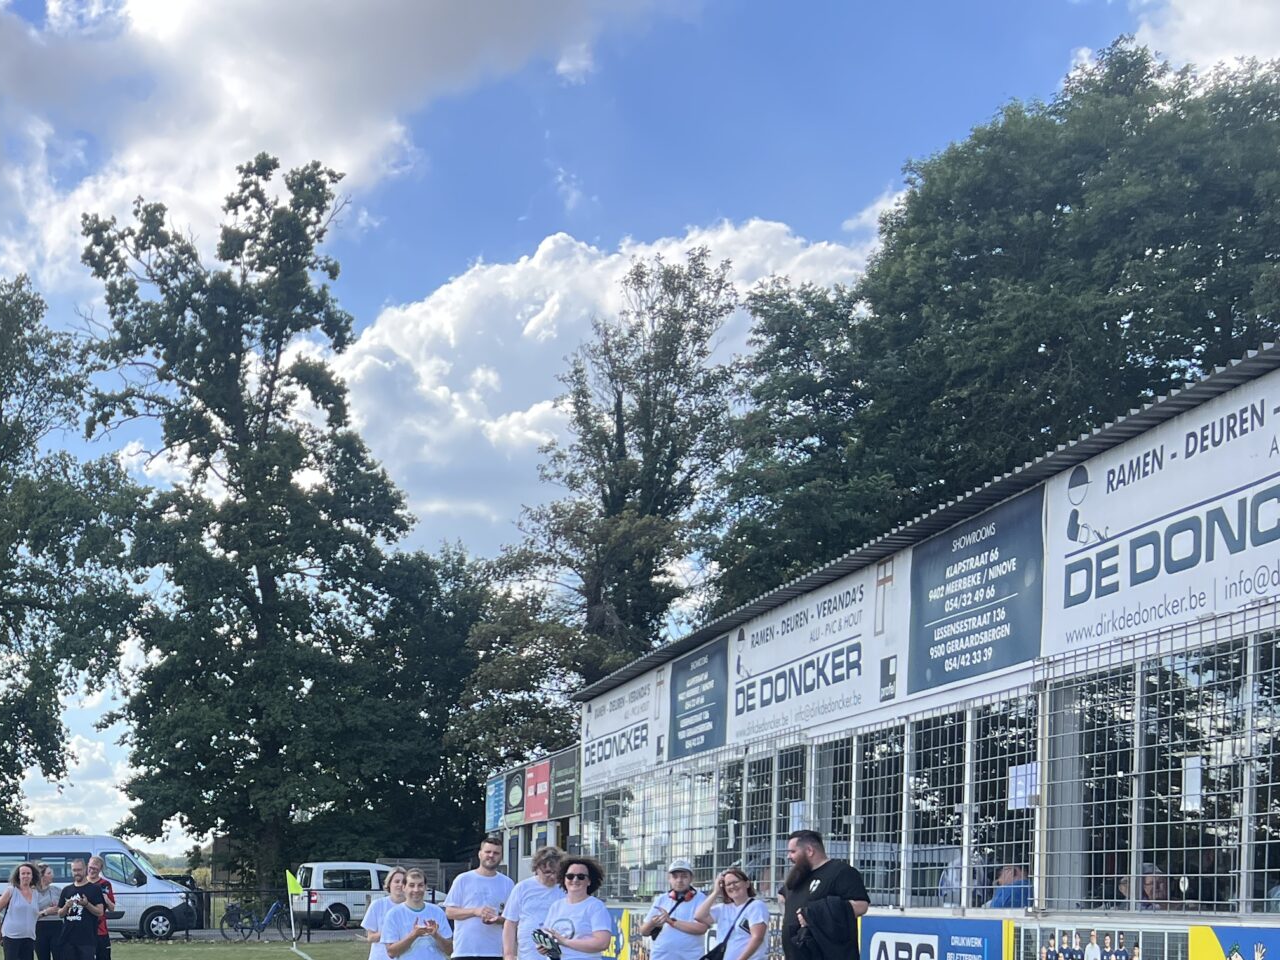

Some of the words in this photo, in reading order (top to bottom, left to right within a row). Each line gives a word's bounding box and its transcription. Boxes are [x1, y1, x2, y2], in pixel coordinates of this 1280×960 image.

[1107, 444, 1164, 494] RAMEN
[1185, 398, 1265, 459] DEUREN
[952, 522, 996, 552] SHOWROOMS
[929, 585, 945, 602] 9402
[945, 572, 982, 596] MEERBEKE
[989, 558, 1017, 581] NINOVE
[945, 552, 989, 579] KLAPSTRAAT
[989, 547, 999, 562] 66
[1064, 544, 1120, 609] DE
[751, 626, 775, 648] RAMEN
[781, 608, 809, 636] DEUREN
[816, 584, 864, 619] VERANDA'S
[944, 595, 972, 613] 054/32
[973, 588, 985, 603] 49
[985, 584, 996, 600] 66
[1065, 586, 1207, 644] www.dirkdedoncker.be
[843, 610, 863, 630] HOUT
[934, 612, 992, 641] LESSENSESTRAAT
[992, 607, 1006, 623] 136
[929, 643, 946, 659] 9500
[946, 623, 1010, 654] GERAARDSBERGEN
[944, 655, 971, 672] 054/42
[972, 650, 982, 665] 33
[983, 647, 993, 661] 39
[735, 681, 756, 716] DE
[760, 641, 862, 708] DONCKER
[584, 743, 596, 767] DE
[597, 723, 649, 762] DONCKER
[951, 936, 983, 948] DRUKWERK
